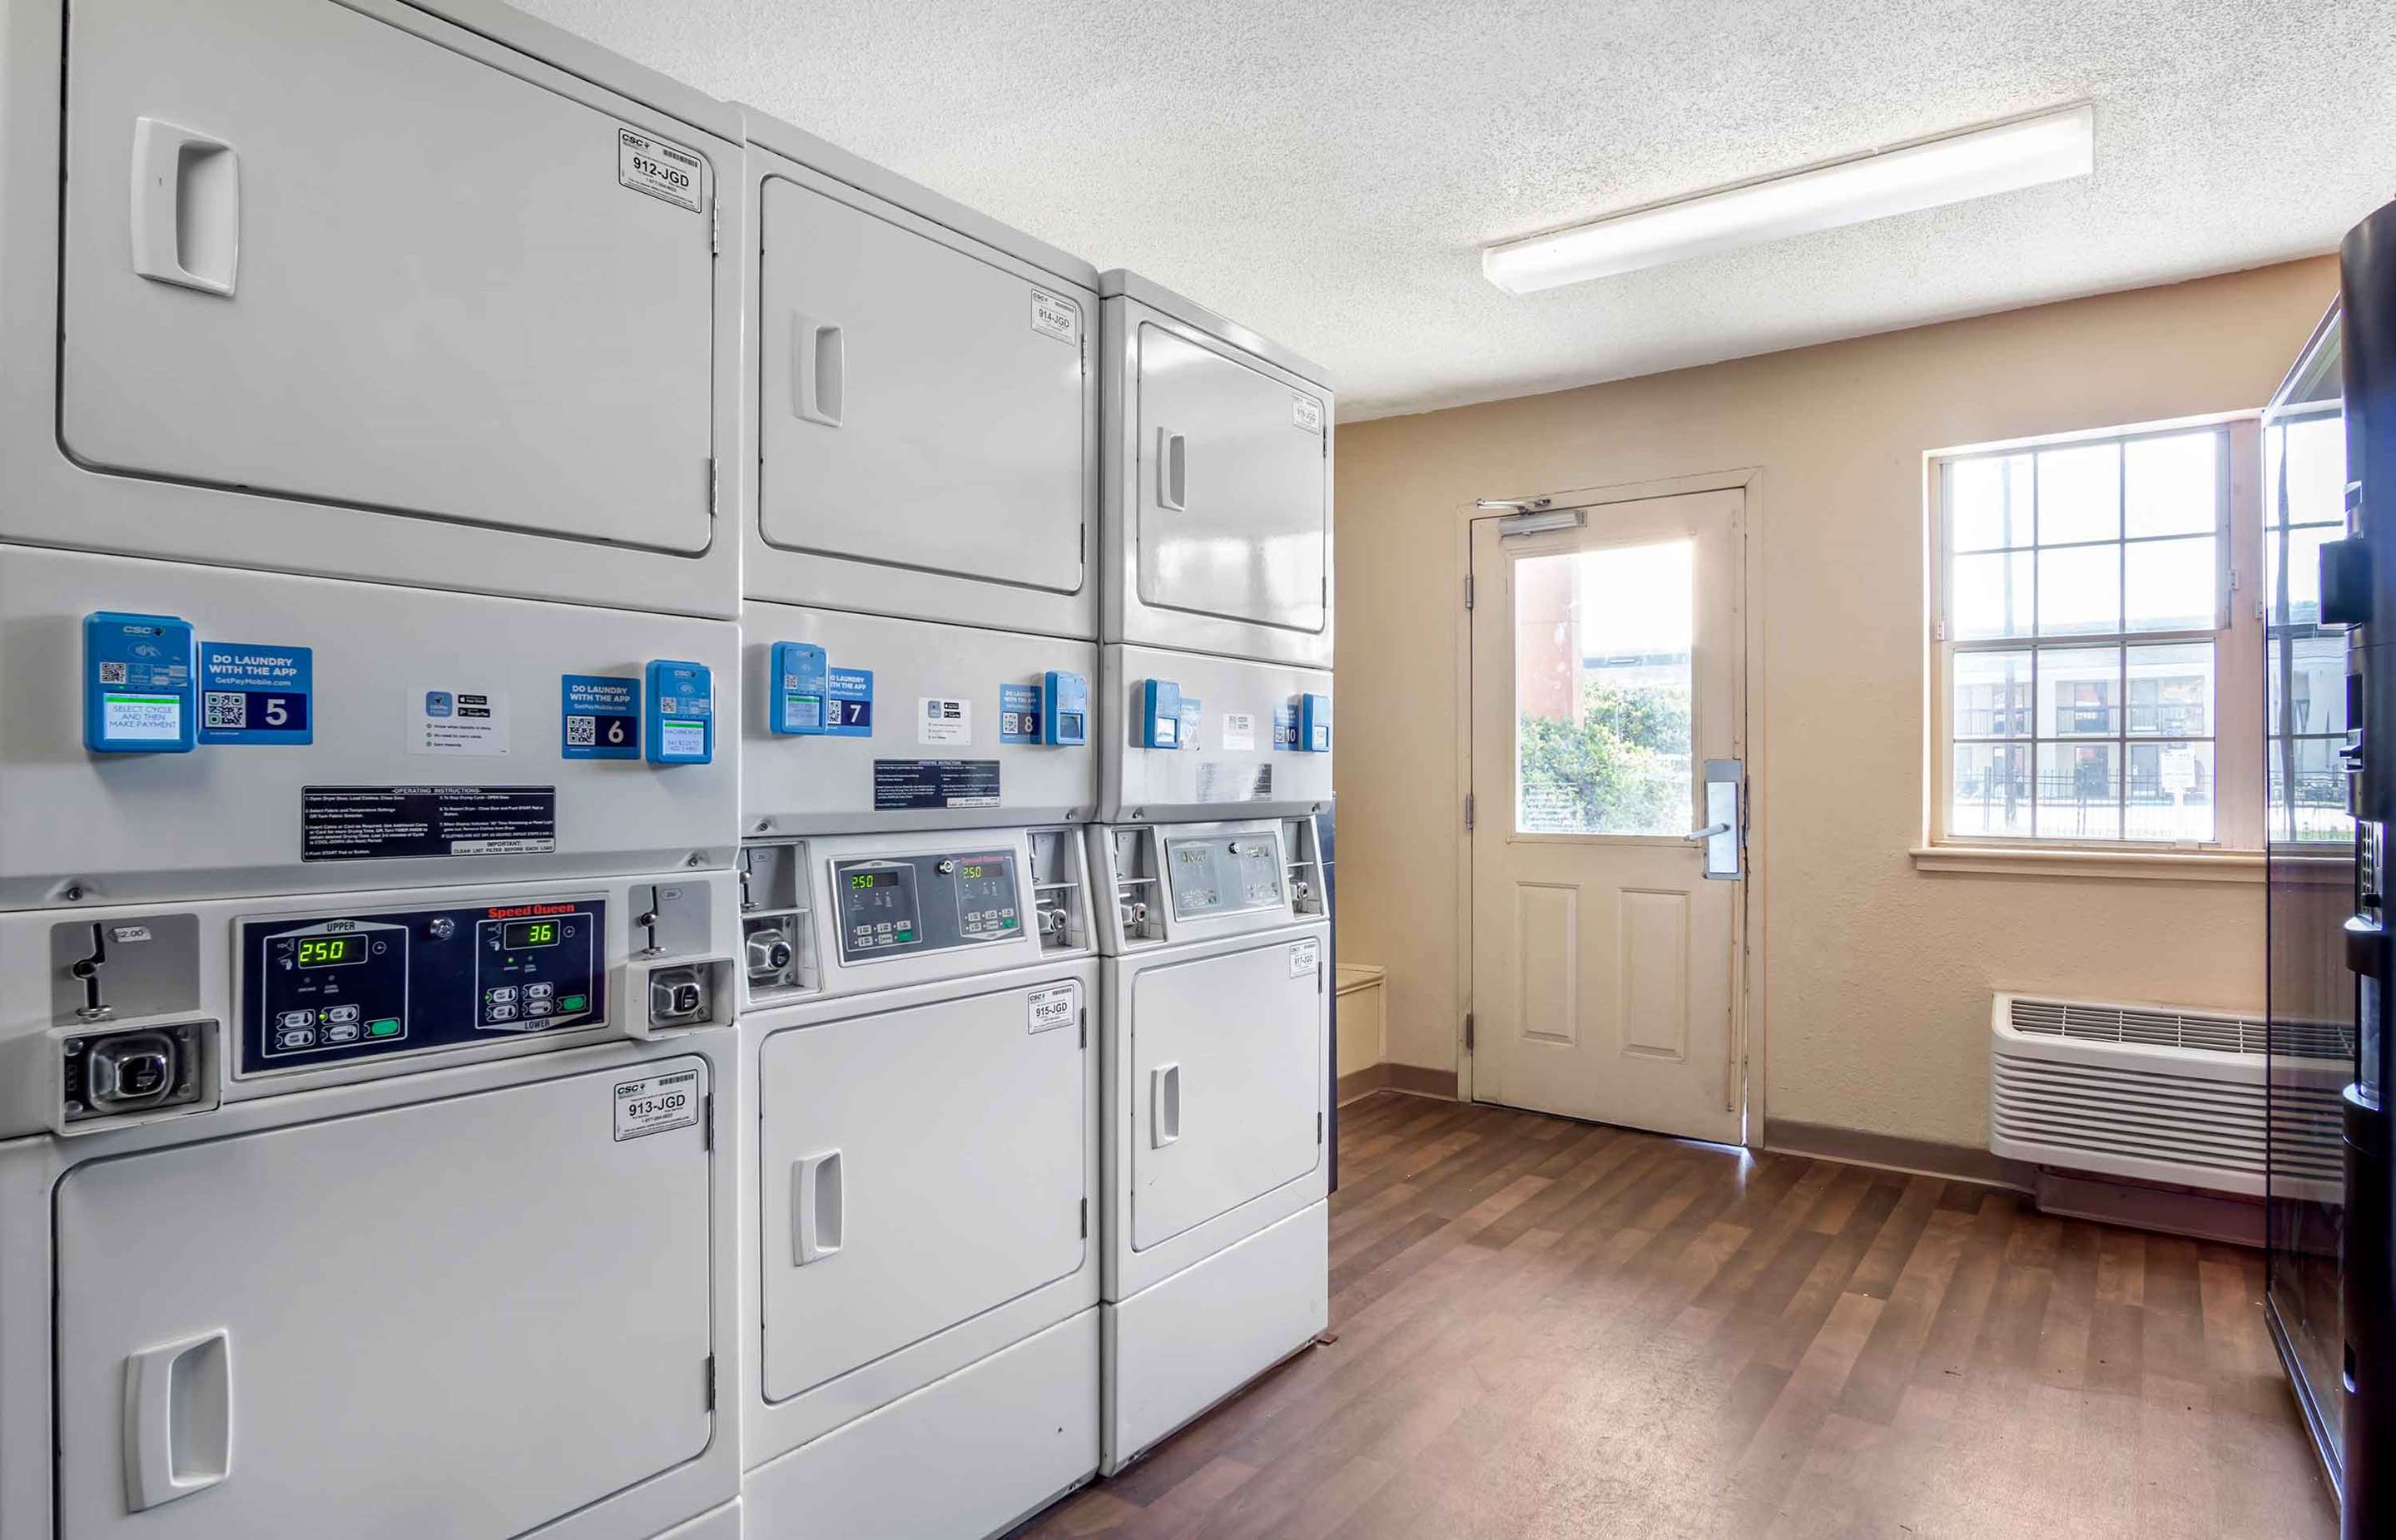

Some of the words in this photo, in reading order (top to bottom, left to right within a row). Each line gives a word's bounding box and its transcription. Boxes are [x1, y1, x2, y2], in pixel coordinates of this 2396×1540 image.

[622, 134, 643, 146] CSC
[633, 157, 689, 187] 912-JGD
[213, 654, 231, 664] DO
[235, 656, 293, 666] LAUNDRY
[209, 664, 243, 674] WITH
[246, 666, 270, 675] THE
[273, 668, 298, 676] APP
[215, 677, 291, 686] GetPayMobile.com
[587, 686, 627, 694] LAUNDRY
[265, 698, 288, 725] 5
[851, 705, 861, 723] 7
[608, 720, 624, 743] 6
[1025, 716, 1033, 733] 8
[488, 906, 531, 919] Speed
[533, 904, 575, 914] Queen
[327, 921, 355, 932] UPPER
[530, 925, 551, 941] 36
[300, 941, 344, 962] 250
[1036, 1002, 1067, 1017] 915-JGD
[525, 1019, 549, 1030] LOWER
[618, 1084, 639, 1094] CSC
[629, 1094, 685, 1116] 913-JGD
